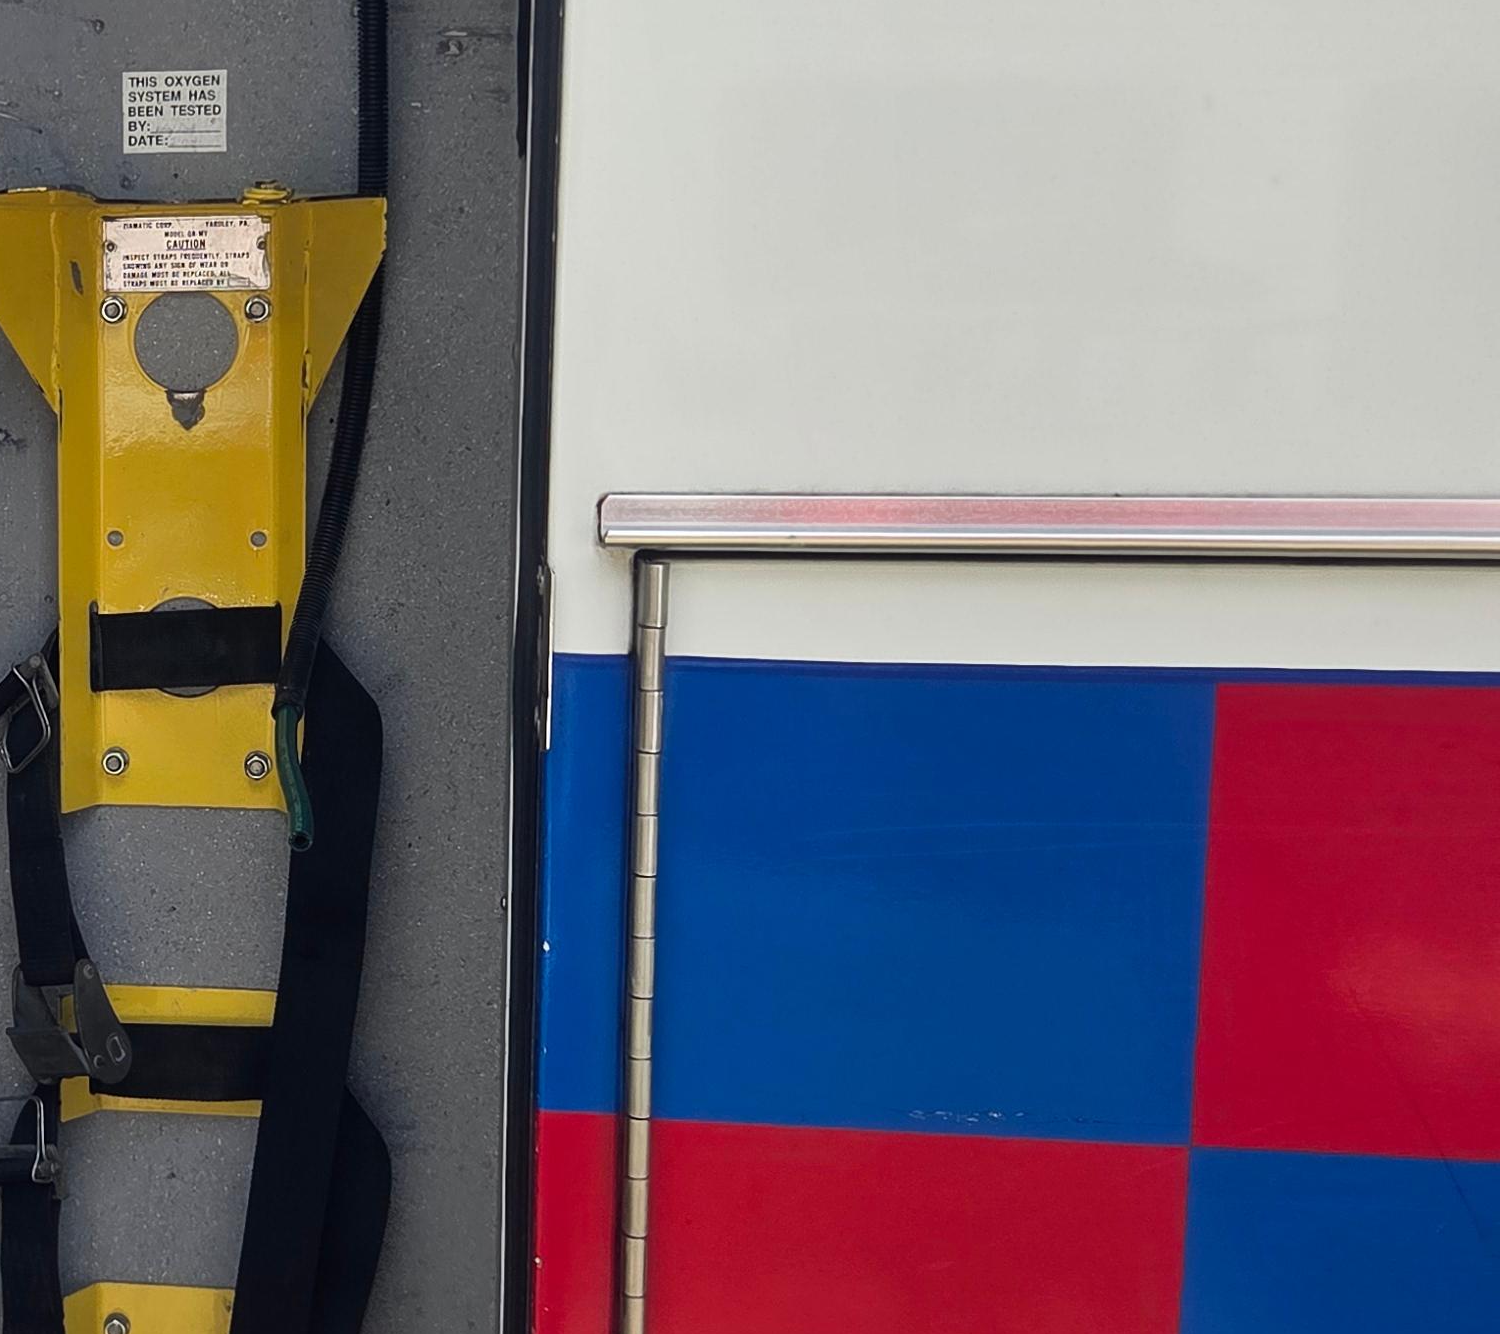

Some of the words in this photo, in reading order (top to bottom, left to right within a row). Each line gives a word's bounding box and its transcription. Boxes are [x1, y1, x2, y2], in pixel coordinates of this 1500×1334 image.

[128, 76, 157, 88] THIS
[164, 75, 220, 87] OXYGEN
[128, 91, 181, 102] SYSTEM
[189, 90, 216, 101] HAS
[128, 106, 163, 117] BEEN
[171, 104, 221, 116] TESTED
[128, 121, 151, 132] BY:
[128, 135, 168, 146] DATE:
[166, 239, 206, 249] CAUTION
[225, 251, 250, 259] STRAPS
[123, 271, 148, 279] DAMAGE
